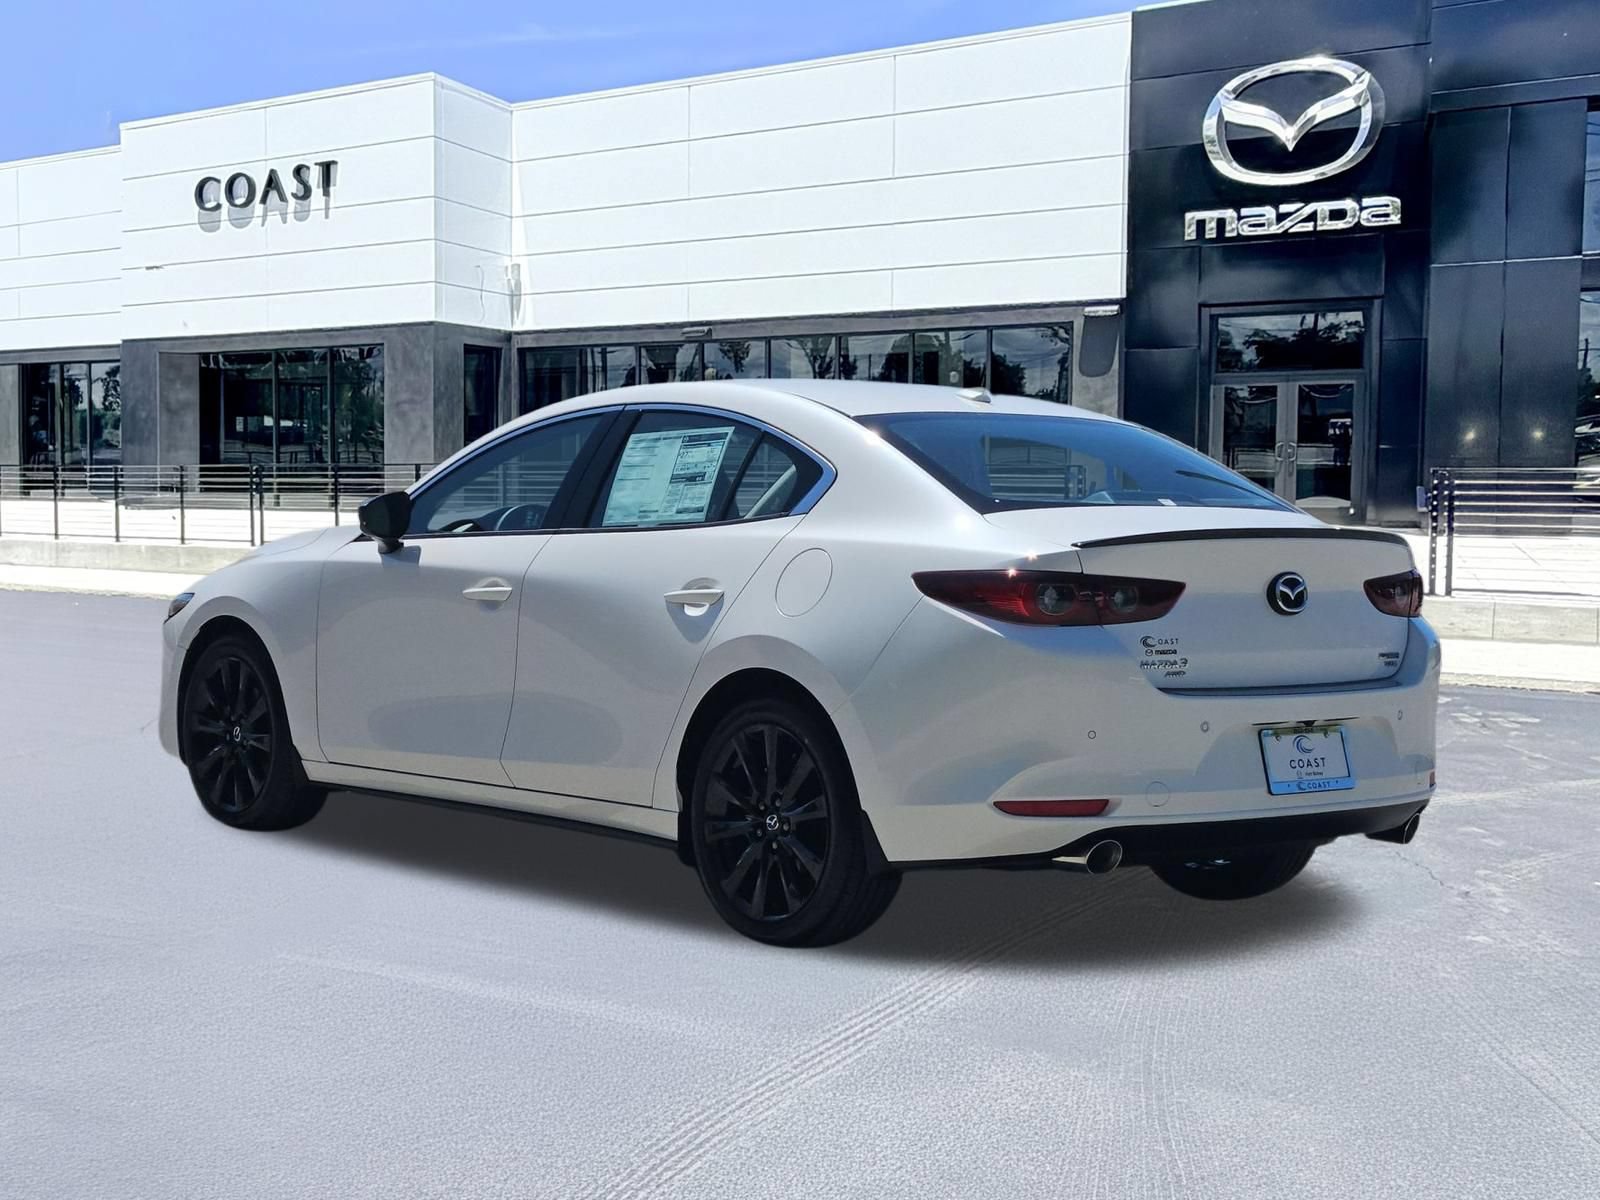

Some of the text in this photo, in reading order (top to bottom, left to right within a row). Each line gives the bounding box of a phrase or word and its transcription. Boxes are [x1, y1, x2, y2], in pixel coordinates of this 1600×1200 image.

[194, 160, 338, 212] COAST
[1289, 757, 1326, 769] COAST
[1307, 781, 1331, 790] COAST
